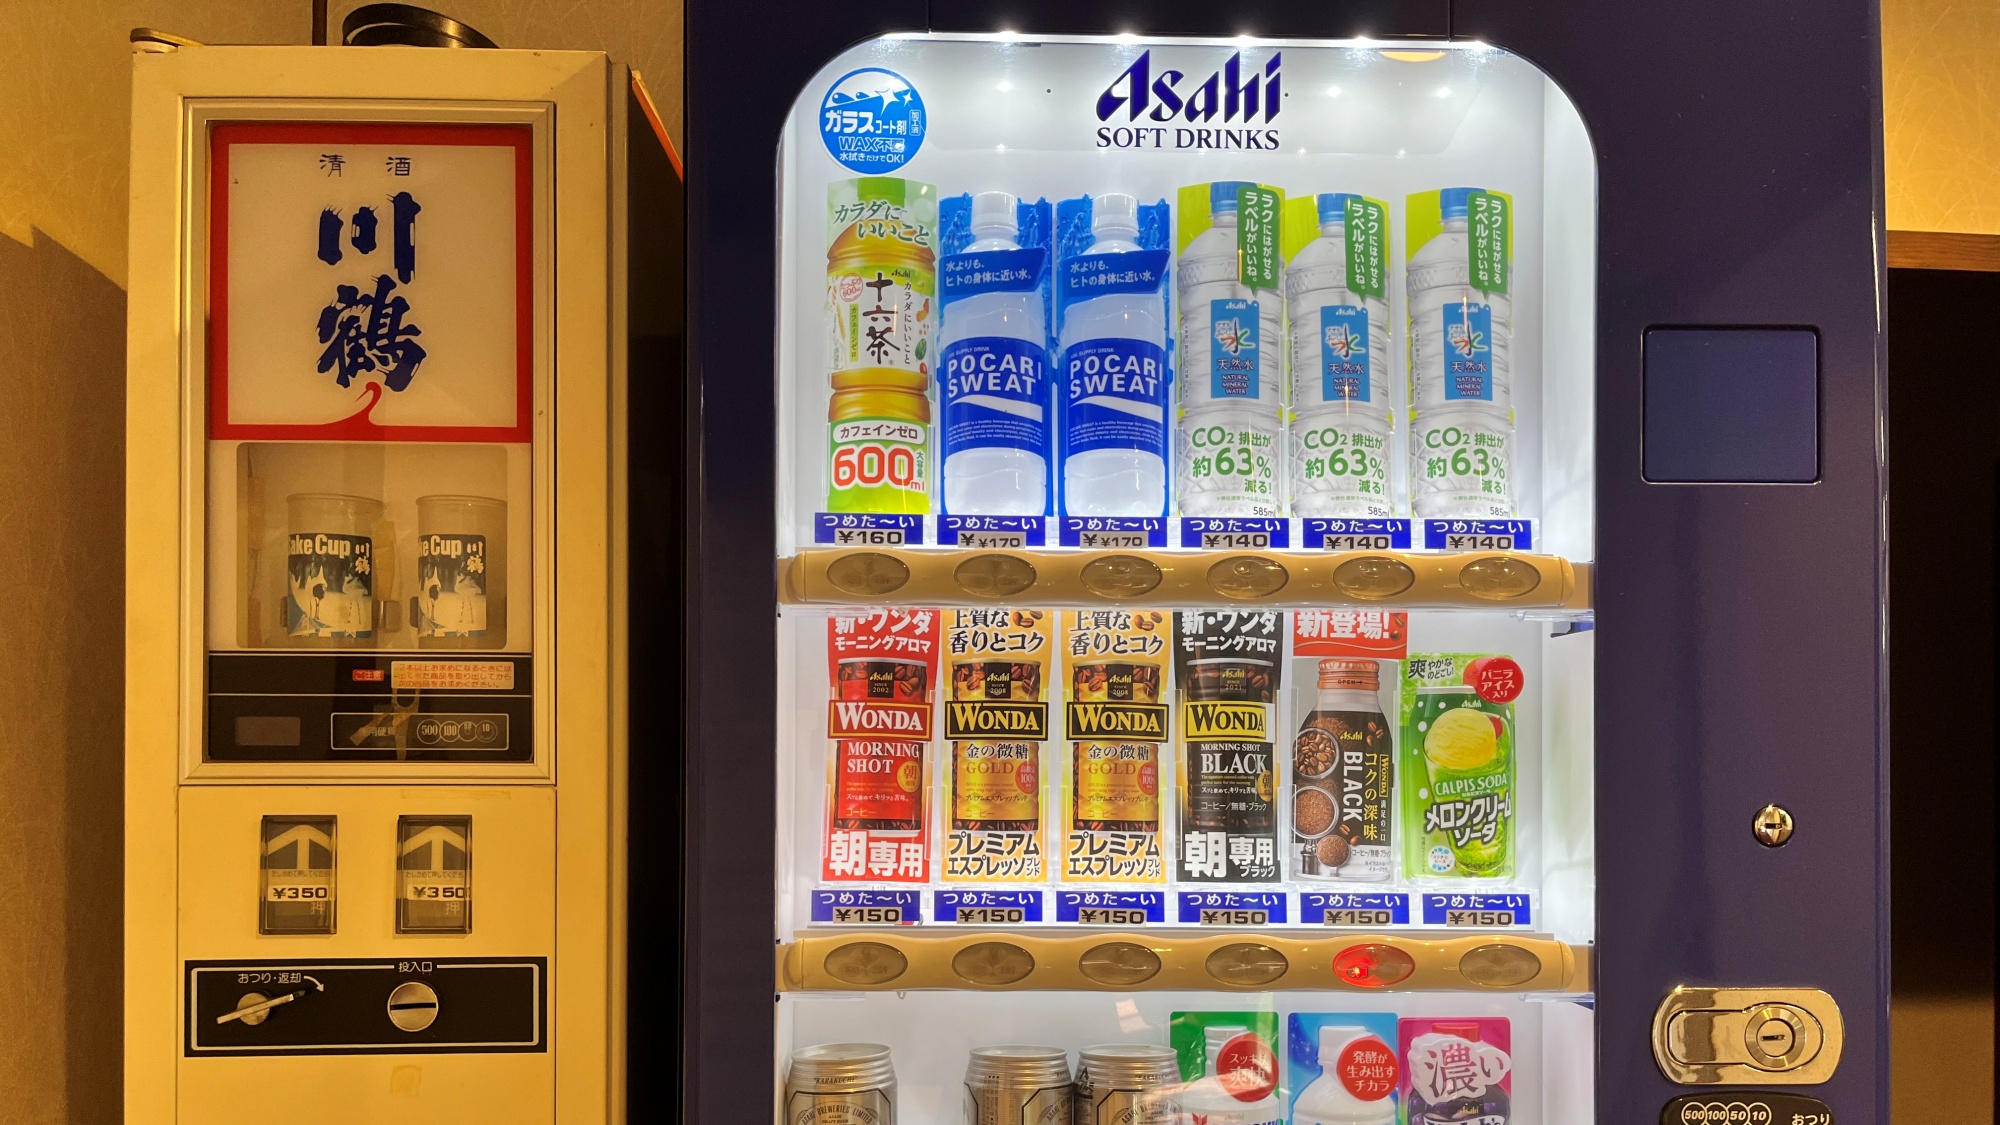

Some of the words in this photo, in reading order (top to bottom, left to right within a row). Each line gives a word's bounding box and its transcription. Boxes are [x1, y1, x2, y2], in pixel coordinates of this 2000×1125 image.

[1096, 49, 1281, 124] Asahi
[1096, 127, 1167, 148] SOFT
[1175, 128, 1280, 150] DRINKS
[319, 154, 412, 178] 清酒
[839, 153, 904, 163] 水拭きだけでOK!
[833, 201, 903, 224] カラダに
[858, 222, 930, 246] いいこと
[1244, 191, 1259, 281] ラベルがいいね。
[1261, 194, 1274, 280] ラクにはがせる
[1475, 198, 1488, 286] ラベルがいいね。
[1491, 200, 1502, 284] ラクにはがせる
[1352, 203, 1365, 290] ラベルがいいね。
[1367, 206, 1379, 288] ラクにはがせる
[891, 269, 911, 278] Asahi
[945, 259, 985, 272] 水よりも、
[1070, 260, 1109, 273] 水よりも、
[945, 268, 1032, 288] ヒトの身体に近い水。
[1070, 270, 1155, 288] ヒトの身体に近い水。
[316, 191, 427, 392] 川鶴
[1225, 302, 1247, 310] Asahi
[1335, 308, 1356, 316] Asahi
[862, 271, 901, 365] 十六茶
[904, 281, 913, 365] カラダにいいこと
[948, 353, 1042, 380] POCARI
[1070, 354, 1163, 381] POCARI
[1217, 359, 1254, 371] 天然水
[1328, 363, 1365, 374] 天然水
[1451, 361, 1487, 373] 天然水
[948, 372, 1037, 399] SWEAT
[1070, 374, 1158, 400] SWEAT
[840, 424, 918, 439] カフェインゼロ
[1239, 431, 1272, 448] 排出が
[1351, 432, 1384, 450] 排出が
[1474, 432, 1504, 449] 排出が
[1192, 447, 1272, 479] 約63%
[1305, 448, 1384, 480] 約63%
[1426, 448, 1505, 479] 約63%
[1244, 479, 1272, 494] 減る!
[1358, 479, 1385, 495] 減る!
[1481, 479, 1506, 495] 減る!
[1253, 506, 1276, 518] 585ml
[1490, 506, 1511, 518] 585ml
[838, 530, 903, 545] ¥160
[978, 537, 1021, 548] ¥170
[1100, 536, 1143, 547] ¥170
[1204, 534, 1268, 548] ¥140
[1326, 536, 1390, 549] ¥140
[1449, 535, 1512, 549] ¥140
[315, 534, 351, 559] Cup
[430, 535, 462, 559] Cup
[949, 608, 1010, 629] 上質な
[1070, 610, 1131, 631] 上質な
[1182, 607, 1278, 635] 新・ワンダ
[1297, 608, 1390, 639] 新登場!
[835, 635, 932, 653] モーニングアロマ
[950, 630, 1044, 654] 香りとコク
[1070, 632, 1163, 656] 香りとコク
[1182, 635, 1277, 653] モーニングアロマ
[870, 672, 893, 681] Asahi
[986, 673, 1010, 682] Asahi
[1109, 674, 1132, 683] Asahi
[1221, 669, 1245, 678] Asahi
[1481, 669, 1513, 681] バニラ
[1481, 680, 1515, 692] アイス
[1492, 690, 1508, 699] 入り
[1461, 700, 1482, 708] Asahi
[421, 724, 438, 736] 500
[443, 725, 457, 736] 100
[482, 723, 490, 732] 10
[1340, 731, 1363, 740] Asahi
[847, 742, 919, 758] MORNING
[966, 743, 1029, 759] 金の微糖
[1088, 744, 1149, 761] 金の微糖
[1201, 743, 1241, 751] MORNING
[1241, 744, 1261, 752] SHOT
[847, 759, 894, 773] SHOT
[966, 762, 1014, 774] GOLD
[1089, 762, 1136, 775] GOLD
[1200, 753, 1267, 774] BLACK
[1380, 755, 1389, 794] WONDA
[1343, 751, 1363, 822] BLACK
[1435, 779, 1476, 796] CALPIS
[1476, 773, 1508, 790] SODA
[1363, 753, 1378, 840] コクの深味
[846, 807, 877, 816] コーヒー
[1426, 791, 1512, 832] メロンクリーム
[949, 831, 1040, 856] プレミアム
[1070, 832, 1160, 857] プレミアム
[829, 830, 924, 878] 朝専用
[1184, 831, 1274, 878] 朝専用
[948, 854, 1026, 876] エスプレッソ
[1068, 855, 1148, 876] エスプレッソ
[1240, 865, 1275, 877] ブラック
[273, 887, 328, 899] ¥350
[413, 886, 471, 899] ¥350
[310, 901, 325, 915] 押
[445, 901, 460, 915] 押
[835, 908, 900, 922] ¥150
[959, 908, 1023, 922] ¥150
[1081, 909, 1145, 924] ¥150
[1202, 910, 1266, 924] ¥150
[1327, 910, 1390, 924] ¥150
[1449, 911, 1513, 925] ¥150
[398, 961, 433, 973] 投入口
[237, 972, 302, 985] おつり・返却
[1352, 1051, 1388, 1064] 発酵が
[1346, 1065, 1396, 1079] 生み出す
[1425, 1043, 1504, 1099] 濃い
[1354, 1079, 1390, 1092] チカラ
[816, 1105, 850, 1115] BREWERIES
[852, 1107, 873, 1125] LIMITED
[1684, 1110, 1704, 1120] 500
[1707, 1110, 1726, 1120] 100
[1730, 1110, 1746, 1120] 50
[1752, 1110, 1766, 1120] 10
[1792, 1113, 1830, 1125] おつり
